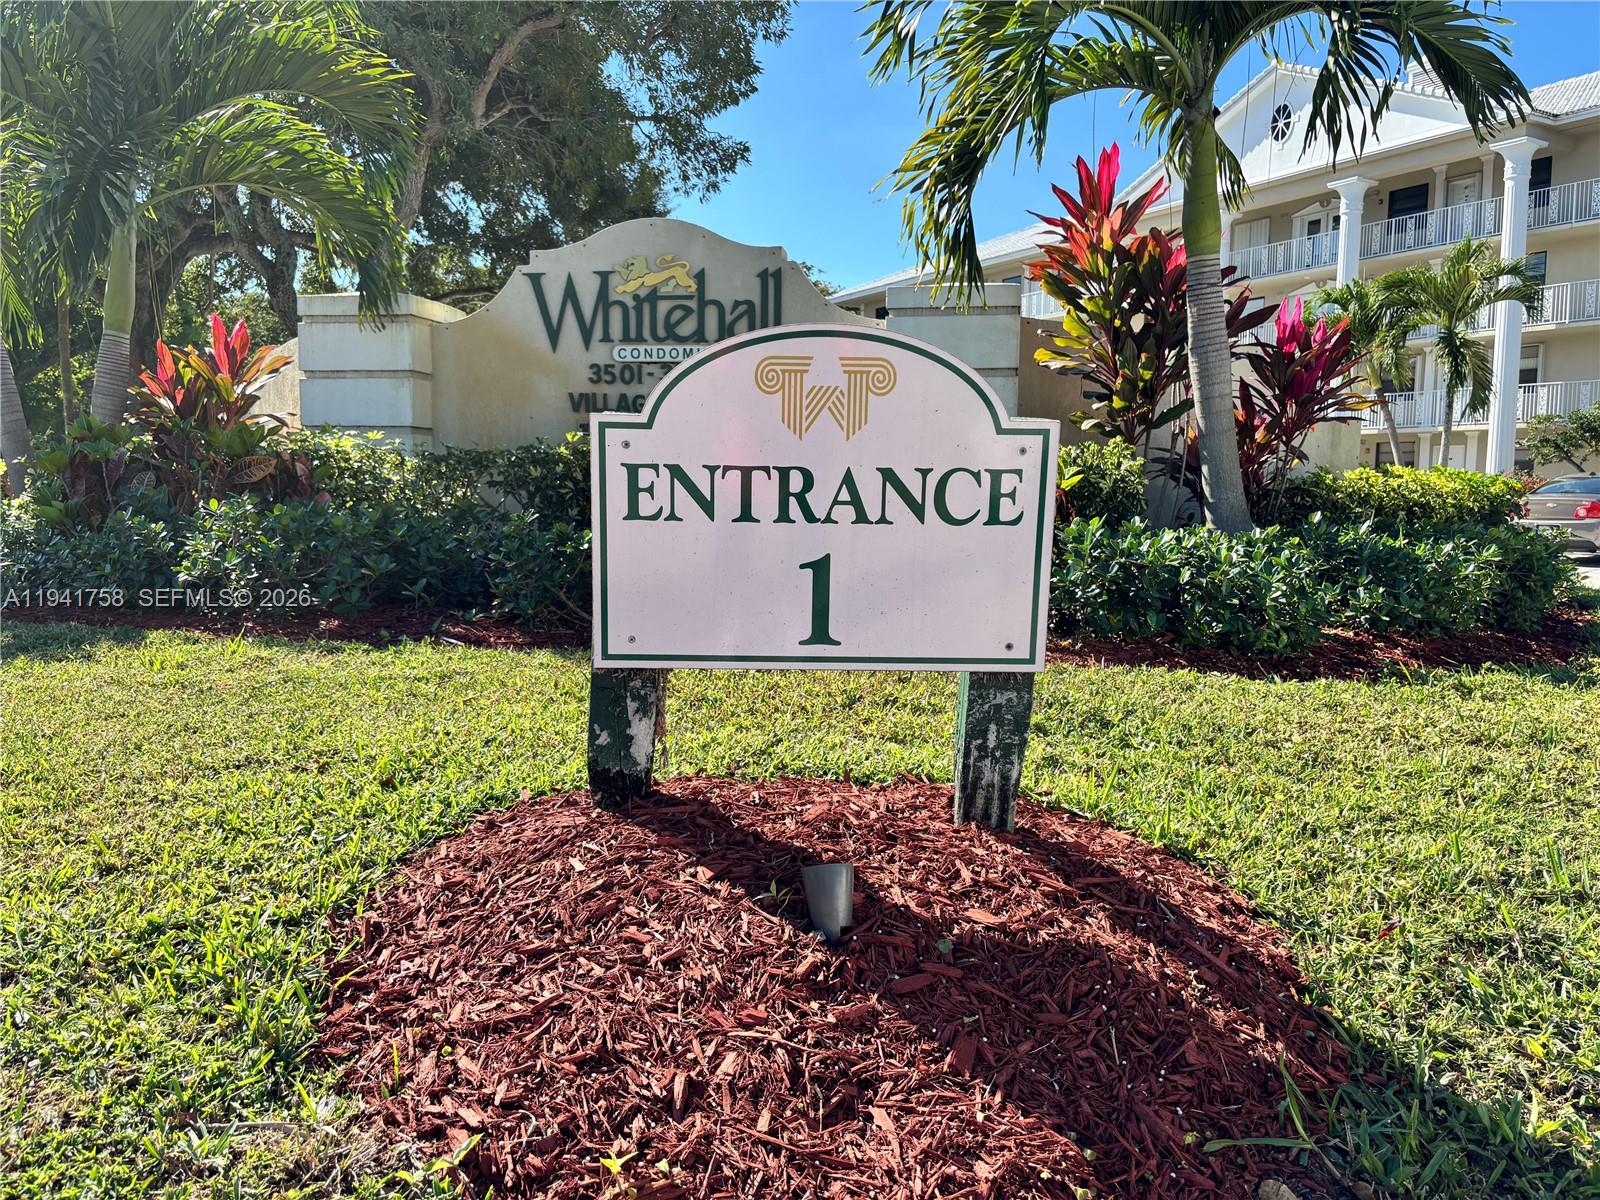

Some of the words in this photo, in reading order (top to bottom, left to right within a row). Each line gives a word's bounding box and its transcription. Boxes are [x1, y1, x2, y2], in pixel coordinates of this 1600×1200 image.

[522, 265, 783, 354] Whitehall
[620, 462, 1025, 527] ENTRANCE
[798, 552, 842, 646] 1
